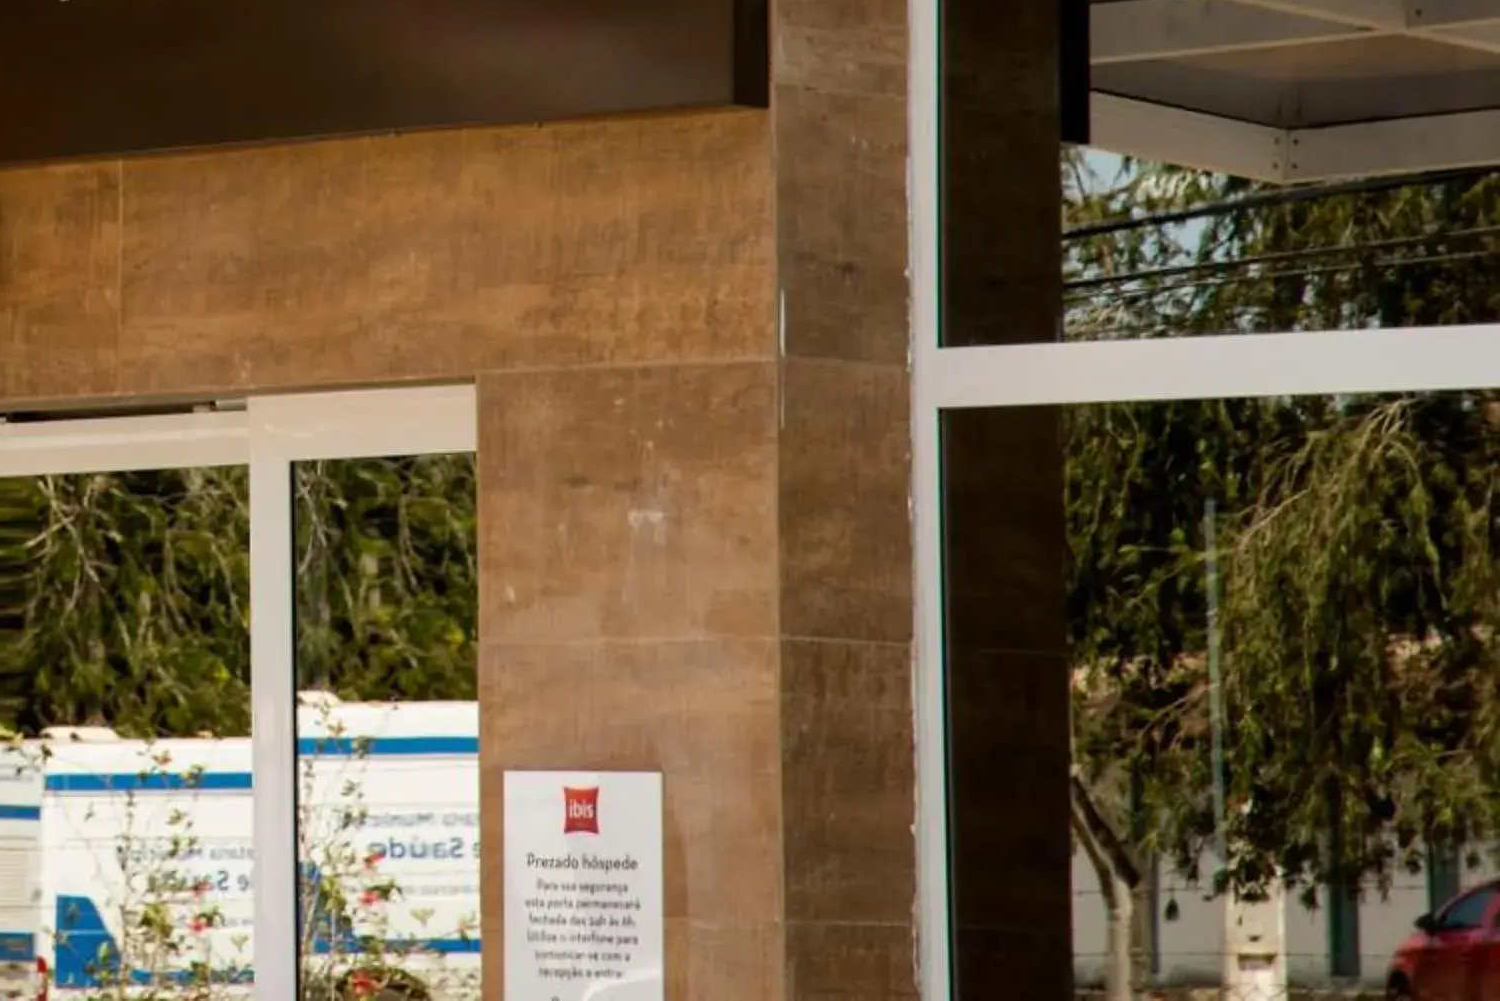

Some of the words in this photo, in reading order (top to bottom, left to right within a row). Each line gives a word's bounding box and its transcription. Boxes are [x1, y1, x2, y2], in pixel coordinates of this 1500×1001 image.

[569, 799, 594, 819] ibis
[527, 852, 579, 870] Prezado
[581, 854, 638, 875] hóspede
[578, 883, 629, 896] segurança
